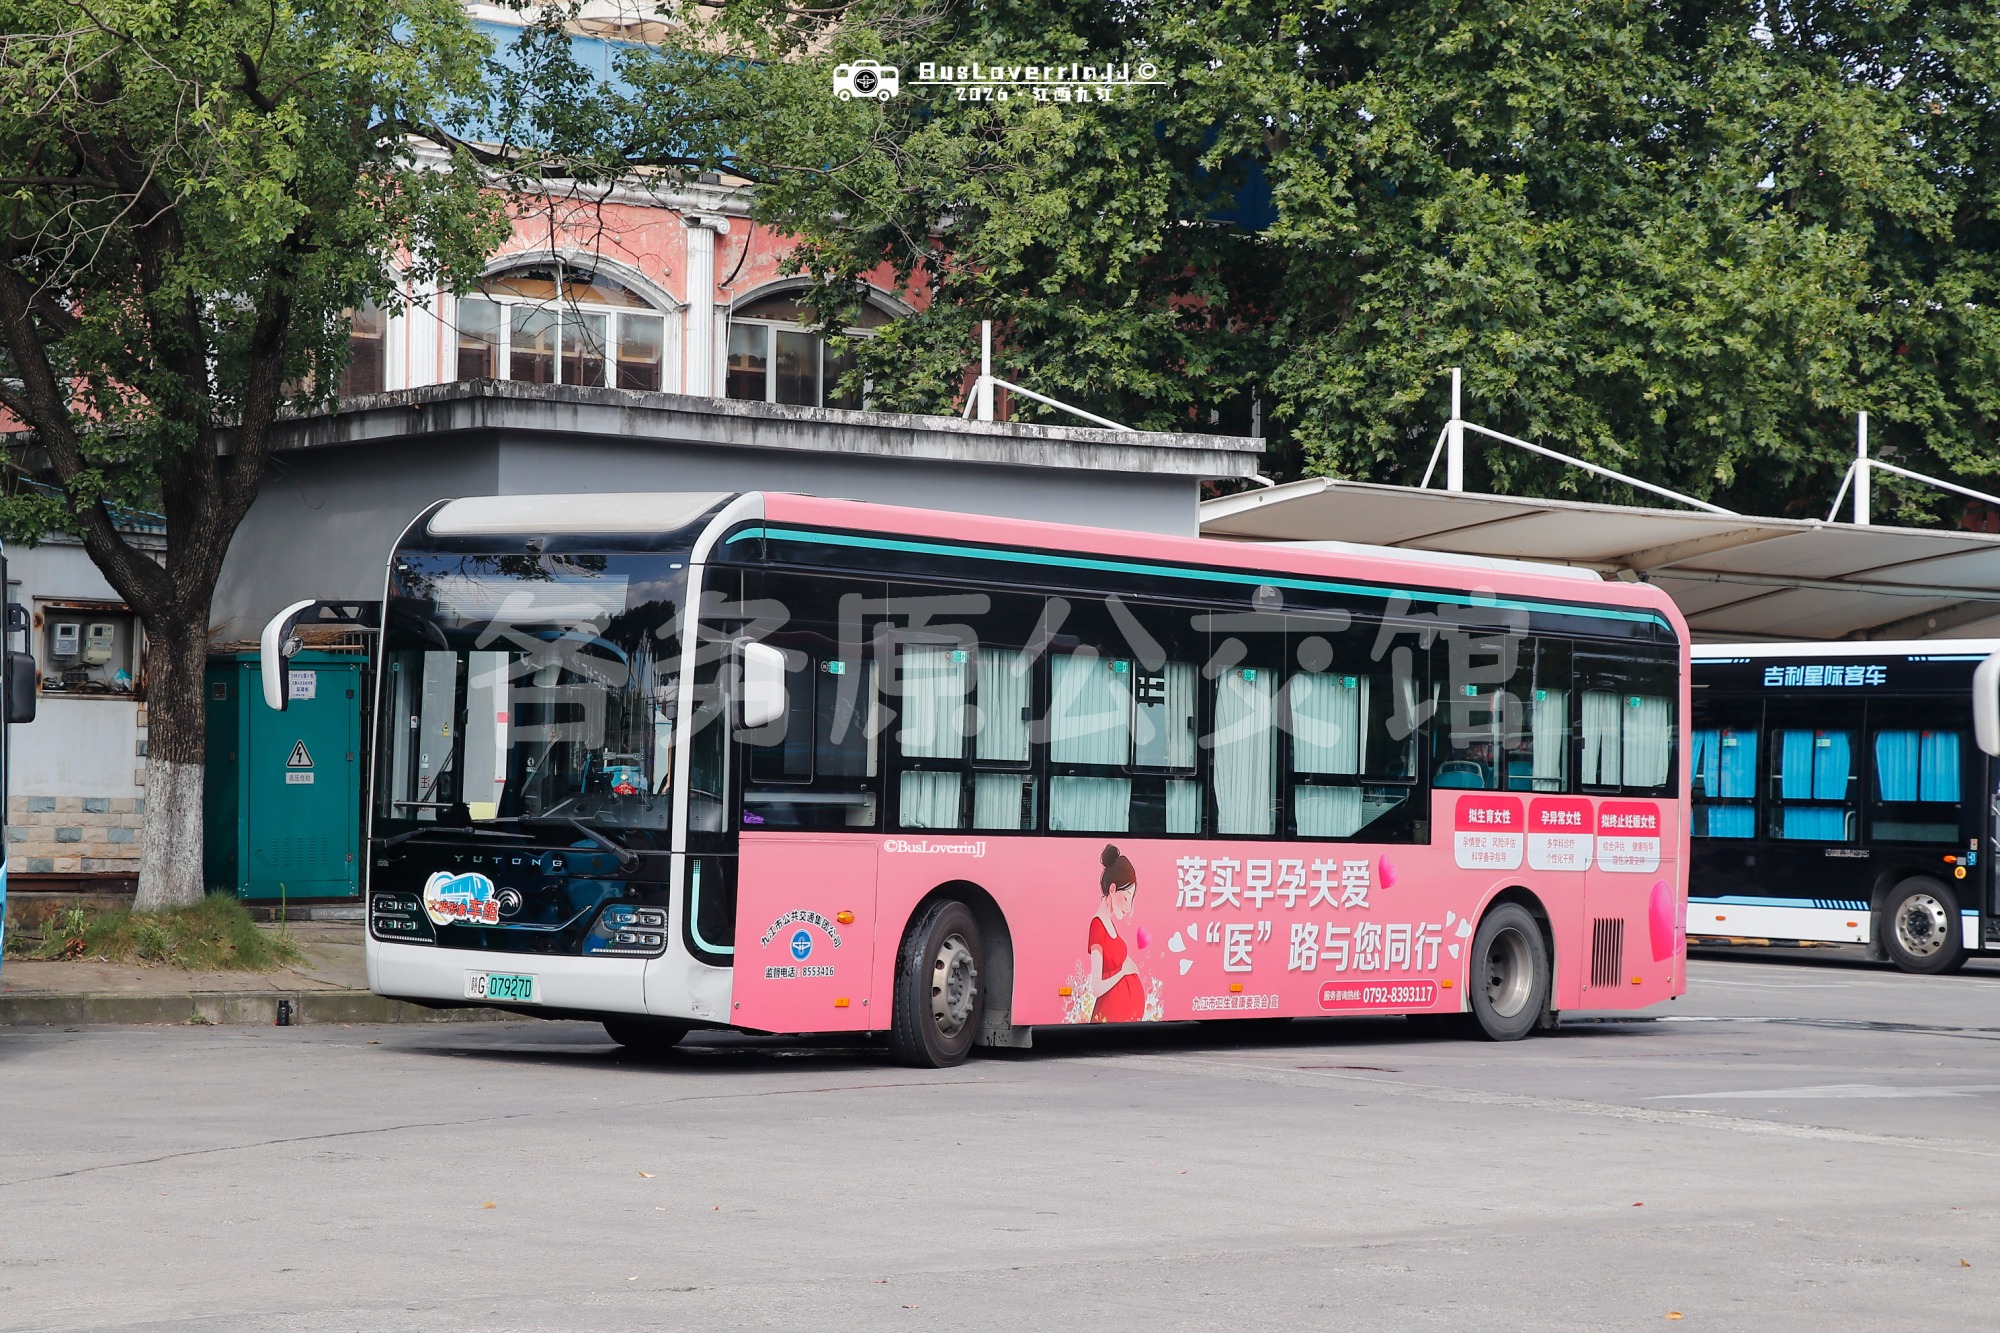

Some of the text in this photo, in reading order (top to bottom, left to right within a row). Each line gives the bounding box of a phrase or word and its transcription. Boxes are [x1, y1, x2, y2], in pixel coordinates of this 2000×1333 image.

[1764, 664, 1888, 687] 吉利星际客车
[1468, 808, 1511, 824] 拟生育女性
[1541, 810, 1582, 826] 孕异常女性
[1601, 813, 1656, 829] 拟终止妊娠女性
[454, 854, 563, 867] YUTONG
[1175, 855, 1371, 909] 落实早孕关爱
[760, 909, 842, 949] 九江市公共交通集团公司
[1362, 986, 1434, 1004] 0792-8393117
